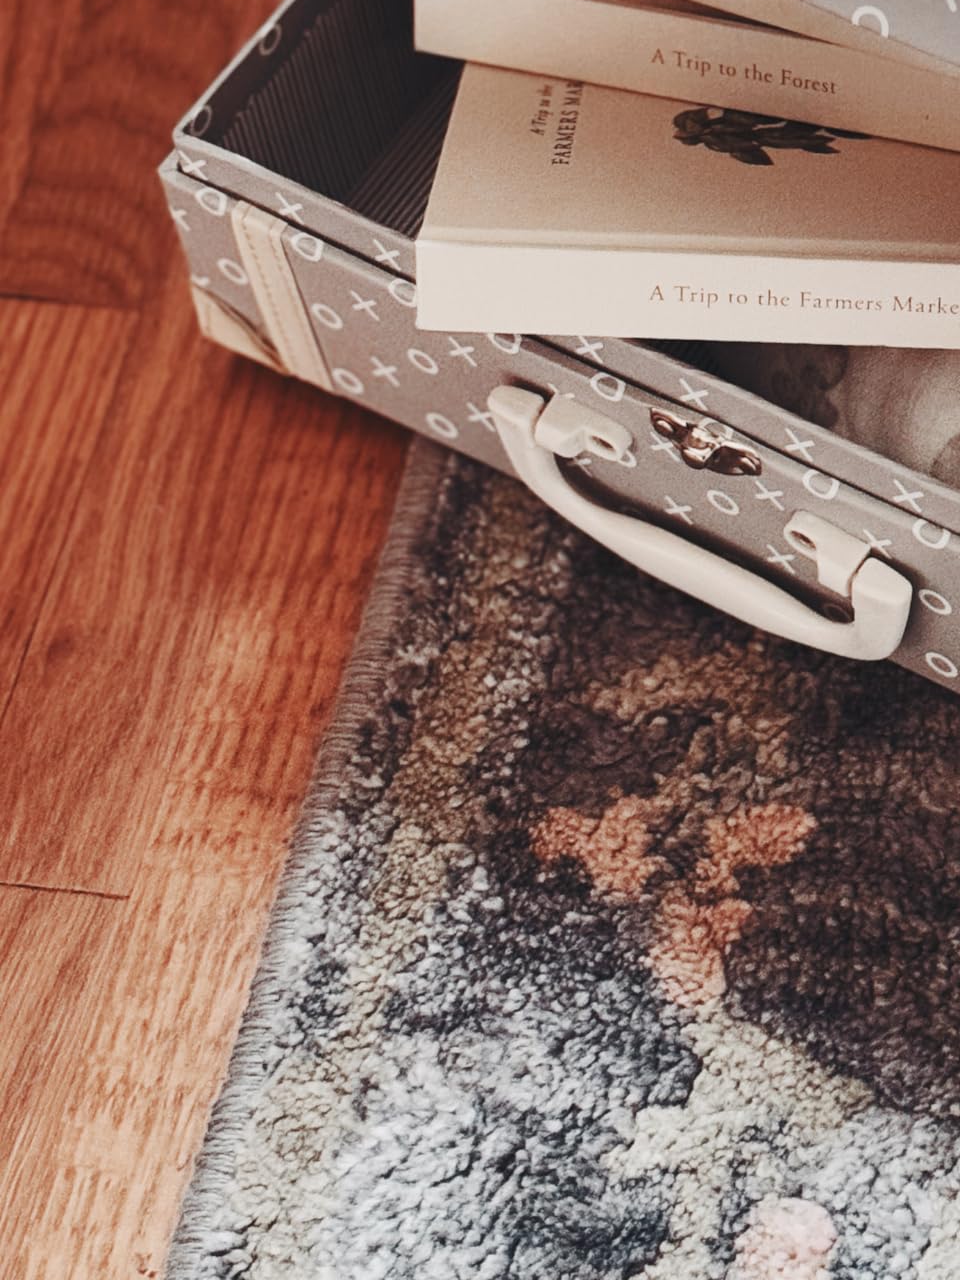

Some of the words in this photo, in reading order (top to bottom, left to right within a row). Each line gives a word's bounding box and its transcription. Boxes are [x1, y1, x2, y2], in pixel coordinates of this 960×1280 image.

[651, 48, 665, 65] A
[673, 50, 711, 77] Trip
[719, 65, 736, 78] to
[744, 64, 773, 83] the
[781, 68, 838, 94] Forest
[530, 128, 545, 136] A
[551, 110, 580, 165] FARMERS
[649, 285, 665, 302] A
[673, 286, 719, 308] Trip
[728, 291, 748, 305] to
[758, 289, 790, 307] the
[799, 291, 883, 312] Farmers
